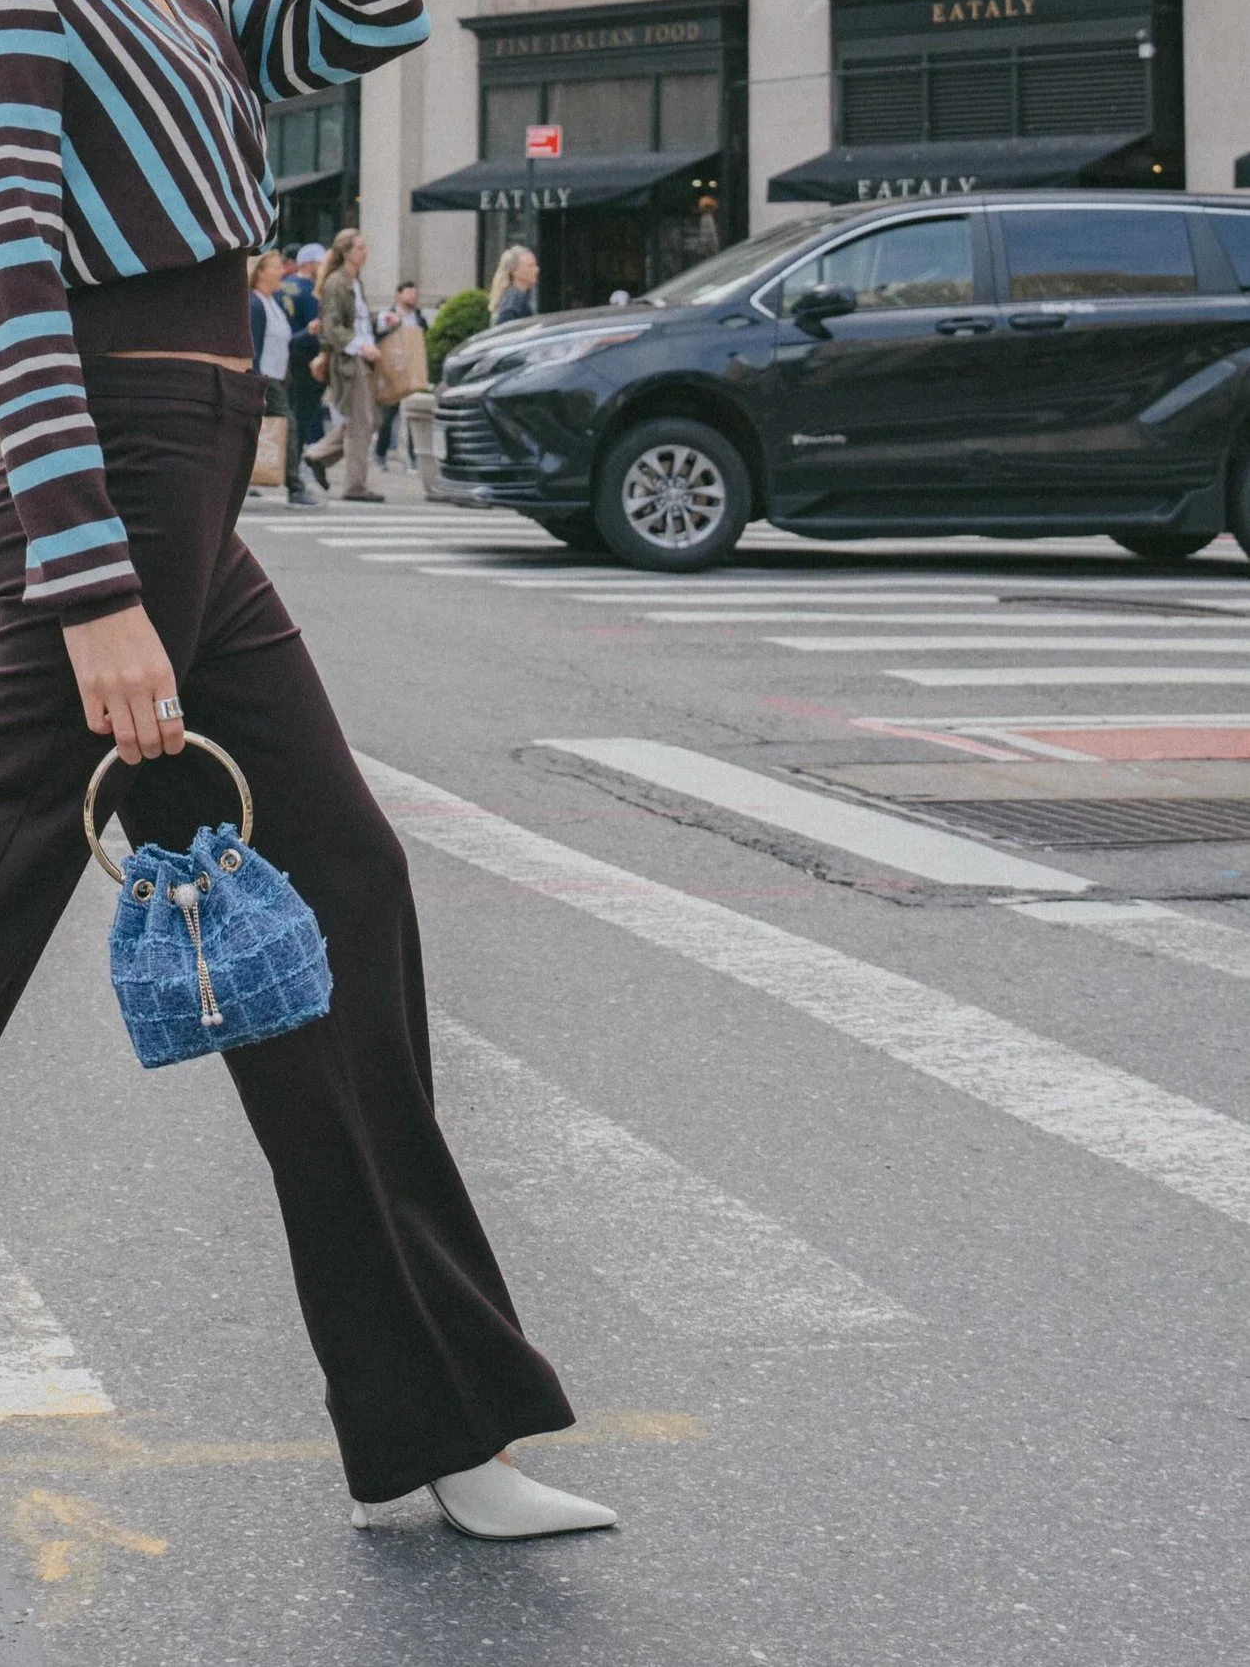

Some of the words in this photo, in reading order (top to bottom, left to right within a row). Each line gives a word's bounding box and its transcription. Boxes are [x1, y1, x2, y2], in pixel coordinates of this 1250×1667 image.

[496, 35, 542, 56] FINE
[551, 27, 634, 53] ITALIAN
[644, 21, 699, 43] FOOD
